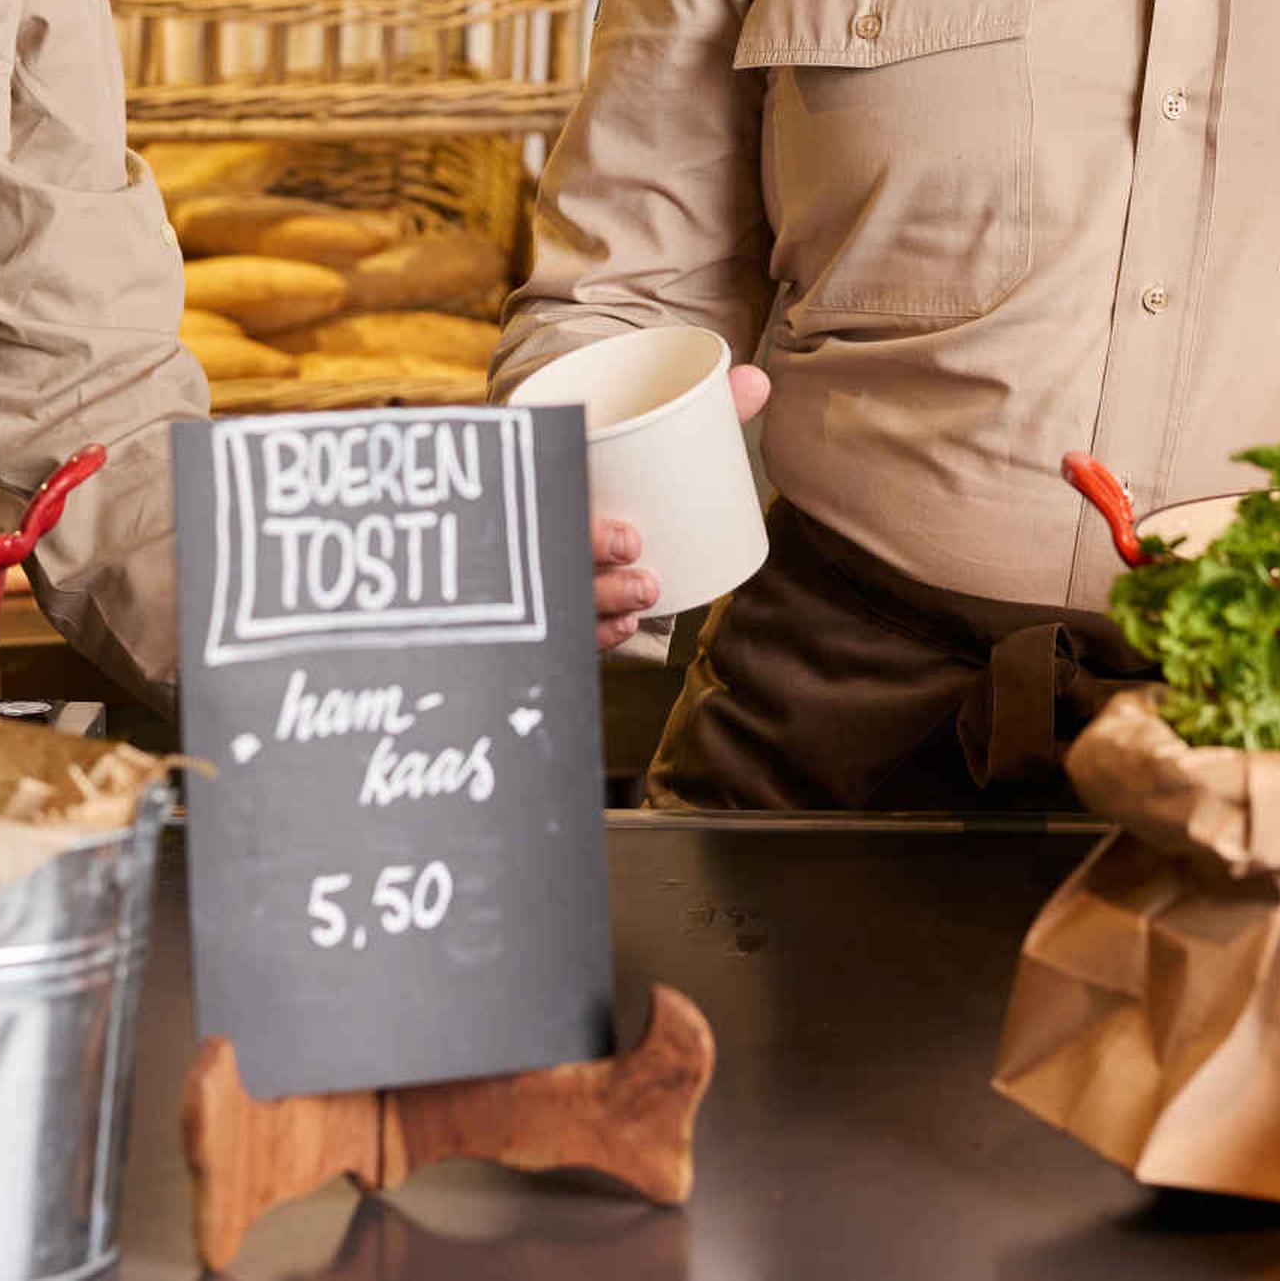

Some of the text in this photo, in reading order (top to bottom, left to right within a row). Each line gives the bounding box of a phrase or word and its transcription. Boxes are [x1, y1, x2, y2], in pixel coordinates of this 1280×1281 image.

[262, 421, 483, 516] BOEREN
[261, 511, 459, 611] TOSTI
[358, 736, 496, 807] kaas
[307, 859, 454, 951] 5,50
